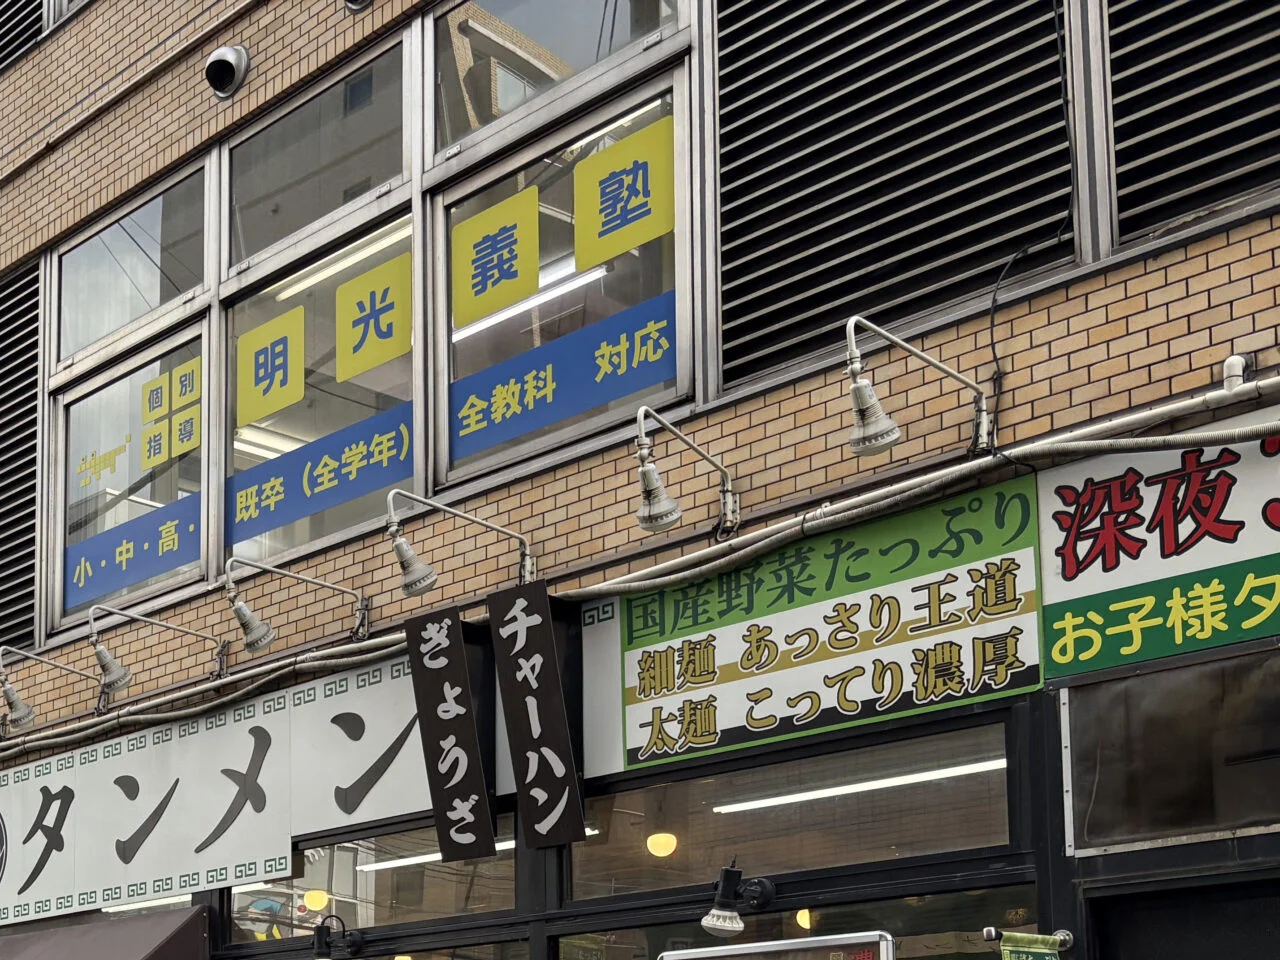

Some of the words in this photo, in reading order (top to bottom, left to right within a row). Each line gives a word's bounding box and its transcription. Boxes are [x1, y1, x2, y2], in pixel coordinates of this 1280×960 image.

[254, 160, 651, 396] 明光義塾
[147, 417, 194, 459] 指導
[148, 369, 194, 413] 個別
[457, 364, 556, 437] 全教科
[594, 320, 670, 383] 対応
[626, 491, 1032, 646] 国産野菜たっぷり
[1052, 437, 1280, 582] 深夜
[637, 634, 718, 699] 細麺
[739, 557, 1023, 672] あっさり王道
[638, 695, 720, 760] 太麺
[745, 626, 1026, 731] こってり濃厚
[420, 618, 479, 844] ぎょうざ
[498, 598, 569, 836] チャーハン
[17, 711, 419, 895] タンメン
